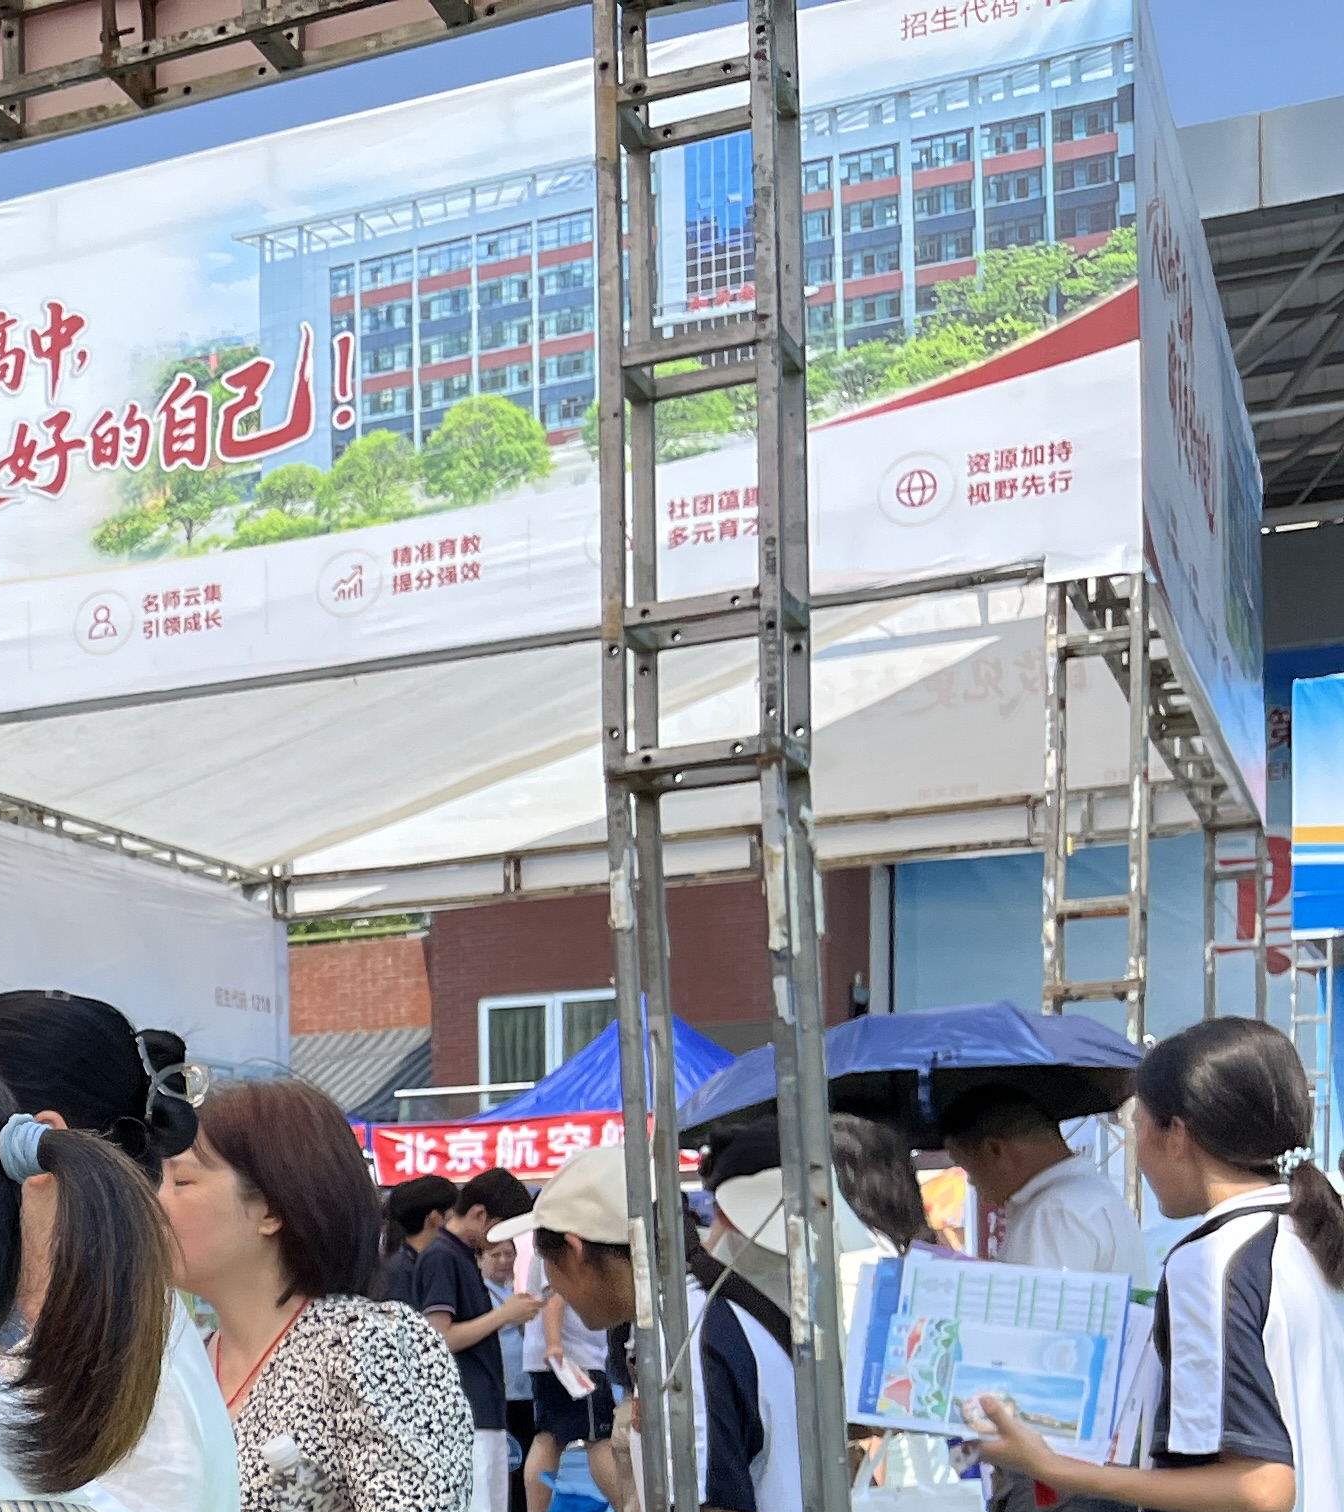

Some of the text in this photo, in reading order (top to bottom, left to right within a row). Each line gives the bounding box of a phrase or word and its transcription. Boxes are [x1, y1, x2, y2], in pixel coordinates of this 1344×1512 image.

[966, 441, 1072, 477] 资源加持
[967, 471, 1072, 505] 视野先行
[142, 585, 223, 614] 名师云集
[143, 609, 223, 639] 引领成长
